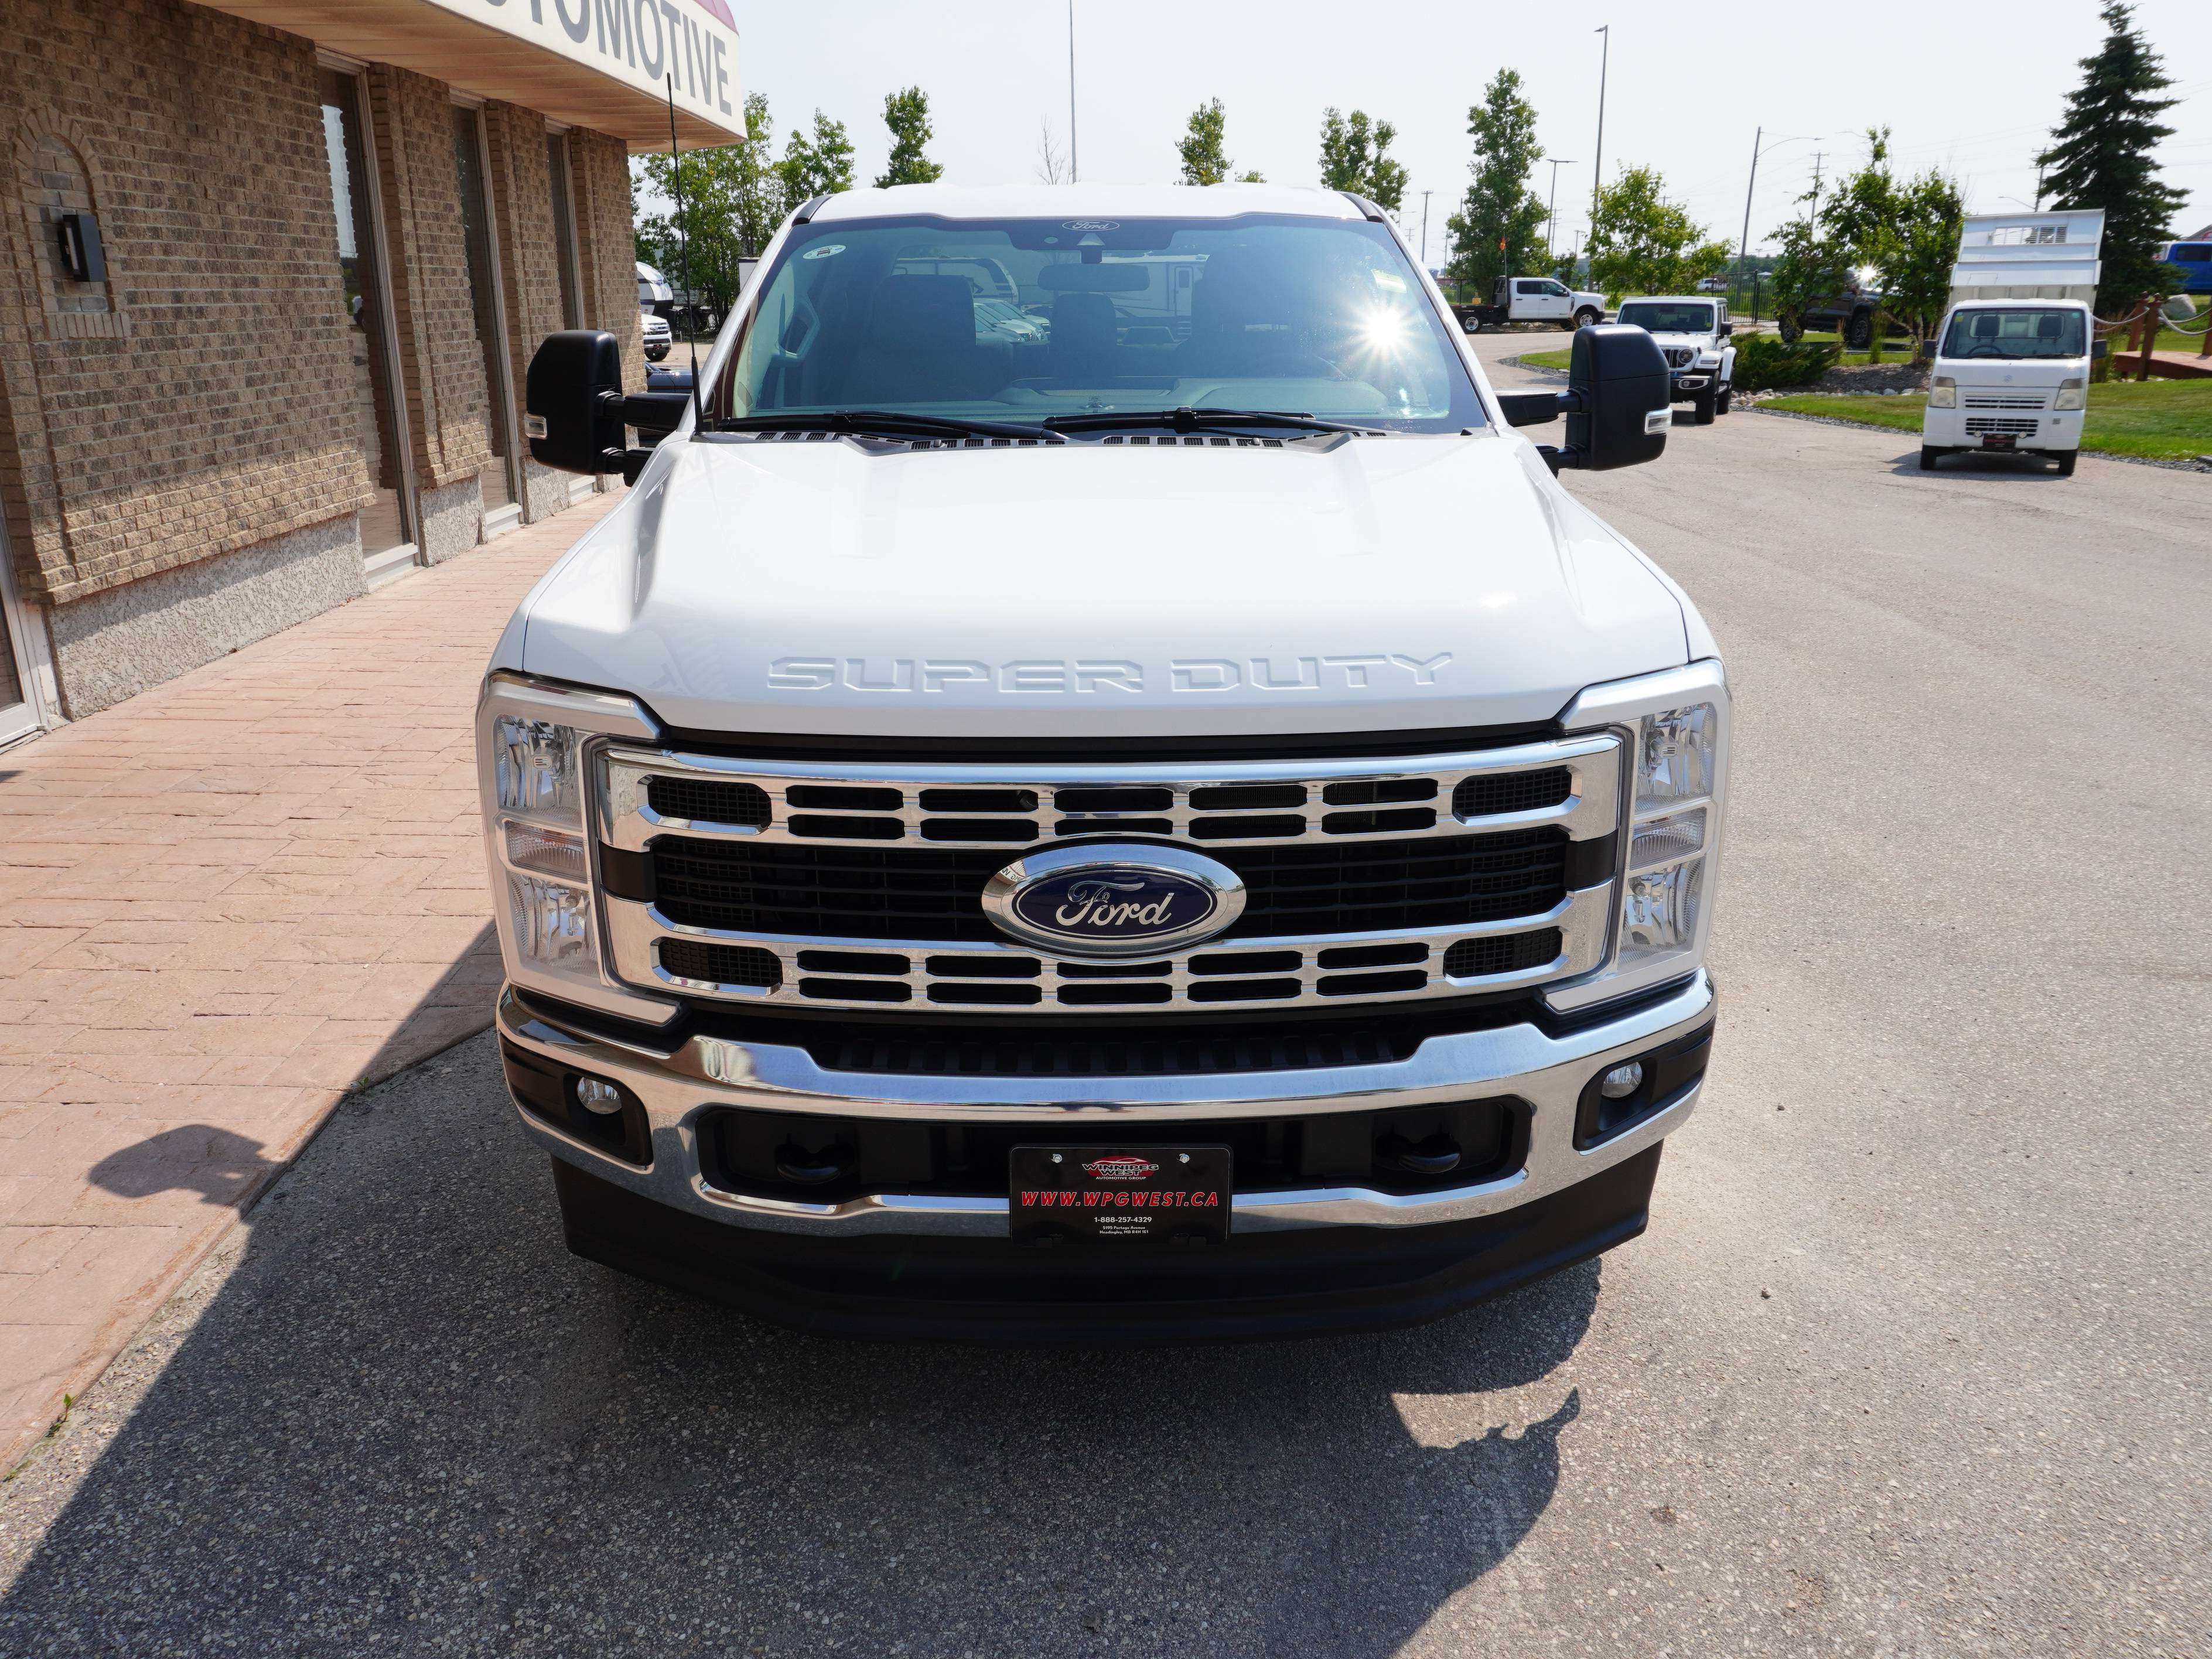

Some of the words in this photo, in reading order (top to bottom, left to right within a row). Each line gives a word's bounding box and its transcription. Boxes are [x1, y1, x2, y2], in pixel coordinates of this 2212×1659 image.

[1072, 221, 1110, 229] Ford
[769, 657, 1143, 692] SUPER
[1171, 652, 1453, 692] DUTY
[1056, 880, 1174, 926] Ford
[1022, 1192, 1218, 1207] WWW.WPGWEST.CA
